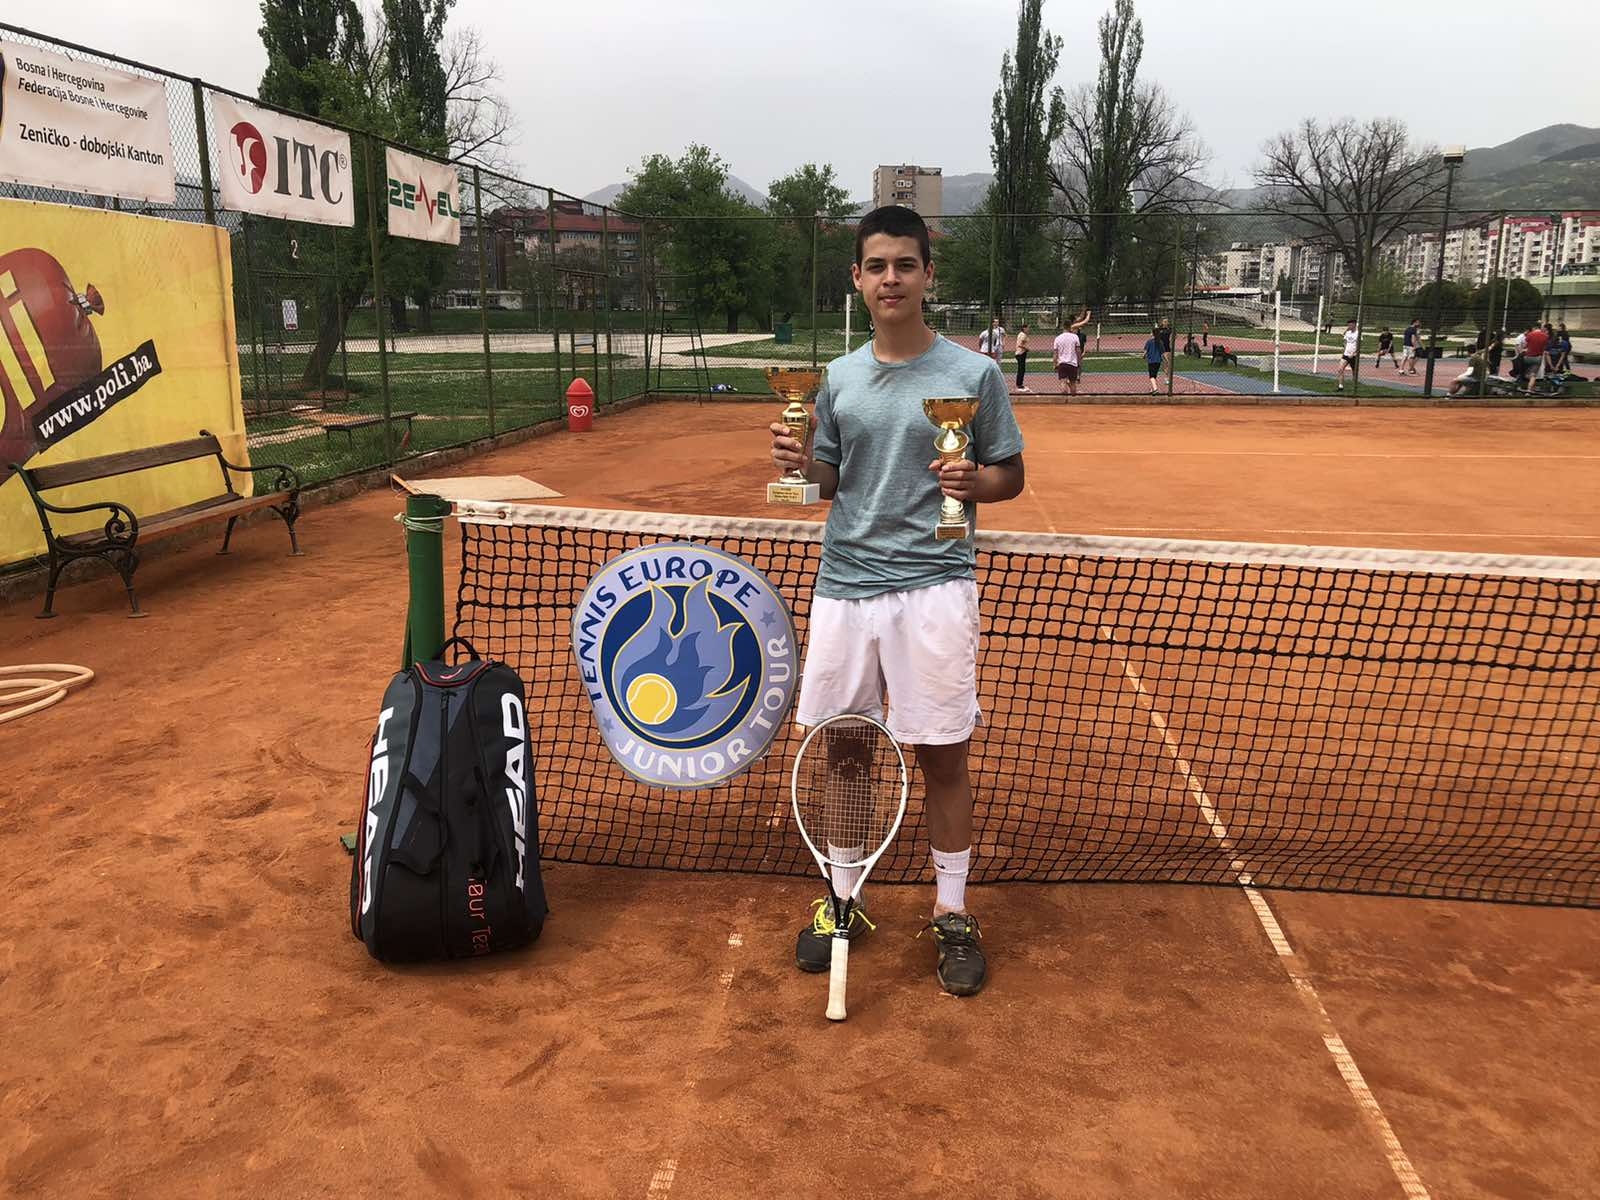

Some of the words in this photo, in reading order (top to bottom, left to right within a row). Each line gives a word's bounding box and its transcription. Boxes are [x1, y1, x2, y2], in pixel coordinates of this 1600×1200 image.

[16, 57, 46, 76] Bosna
[52, 67, 105, 92] Hercegovina
[18, 78, 67, 102] Federacija
[68, 90, 95, 107] Bosne
[100, 99, 148, 120] Hercegovine
[19, 123, 70, 148] Zeničko
[80, 135, 125, 160] dobojski
[127, 145, 164, 165] Kanton
[38, 354, 152, 440] www.poli.ba
[579, 585, 617, 705] TENNIS
[618, 556, 761, 608] EUROPE
[616, 738, 753, 779] JUNIOR
[749, 633, 790, 731] TOUR
[361, 706, 394, 915] HEAD
[501, 692, 527, 897] HEAD
[468, 878, 488, 919] our
